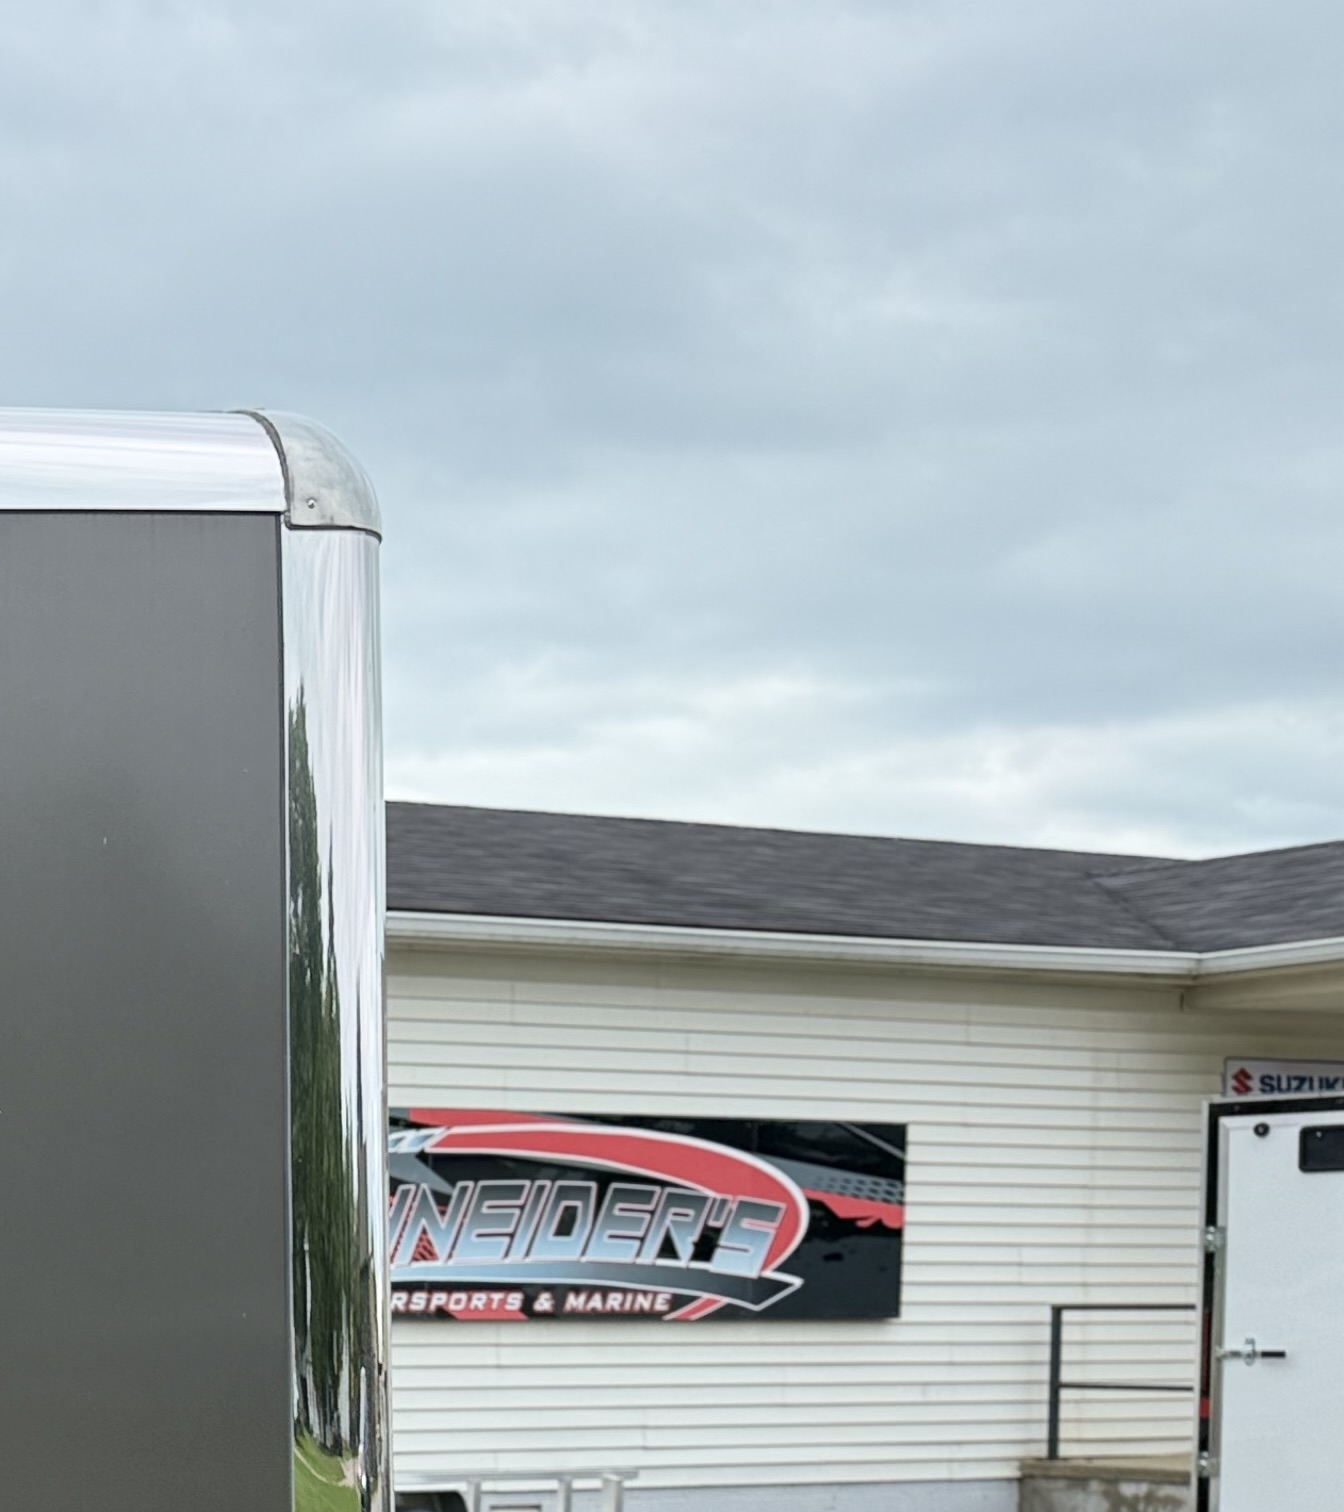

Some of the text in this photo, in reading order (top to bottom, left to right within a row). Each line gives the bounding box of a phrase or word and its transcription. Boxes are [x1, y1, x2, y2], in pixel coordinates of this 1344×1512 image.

[1259, 1074, 1344, 1094] SUZUK
[533, 1292, 555, 1313] &
[564, 1291, 672, 1313] MARINE
